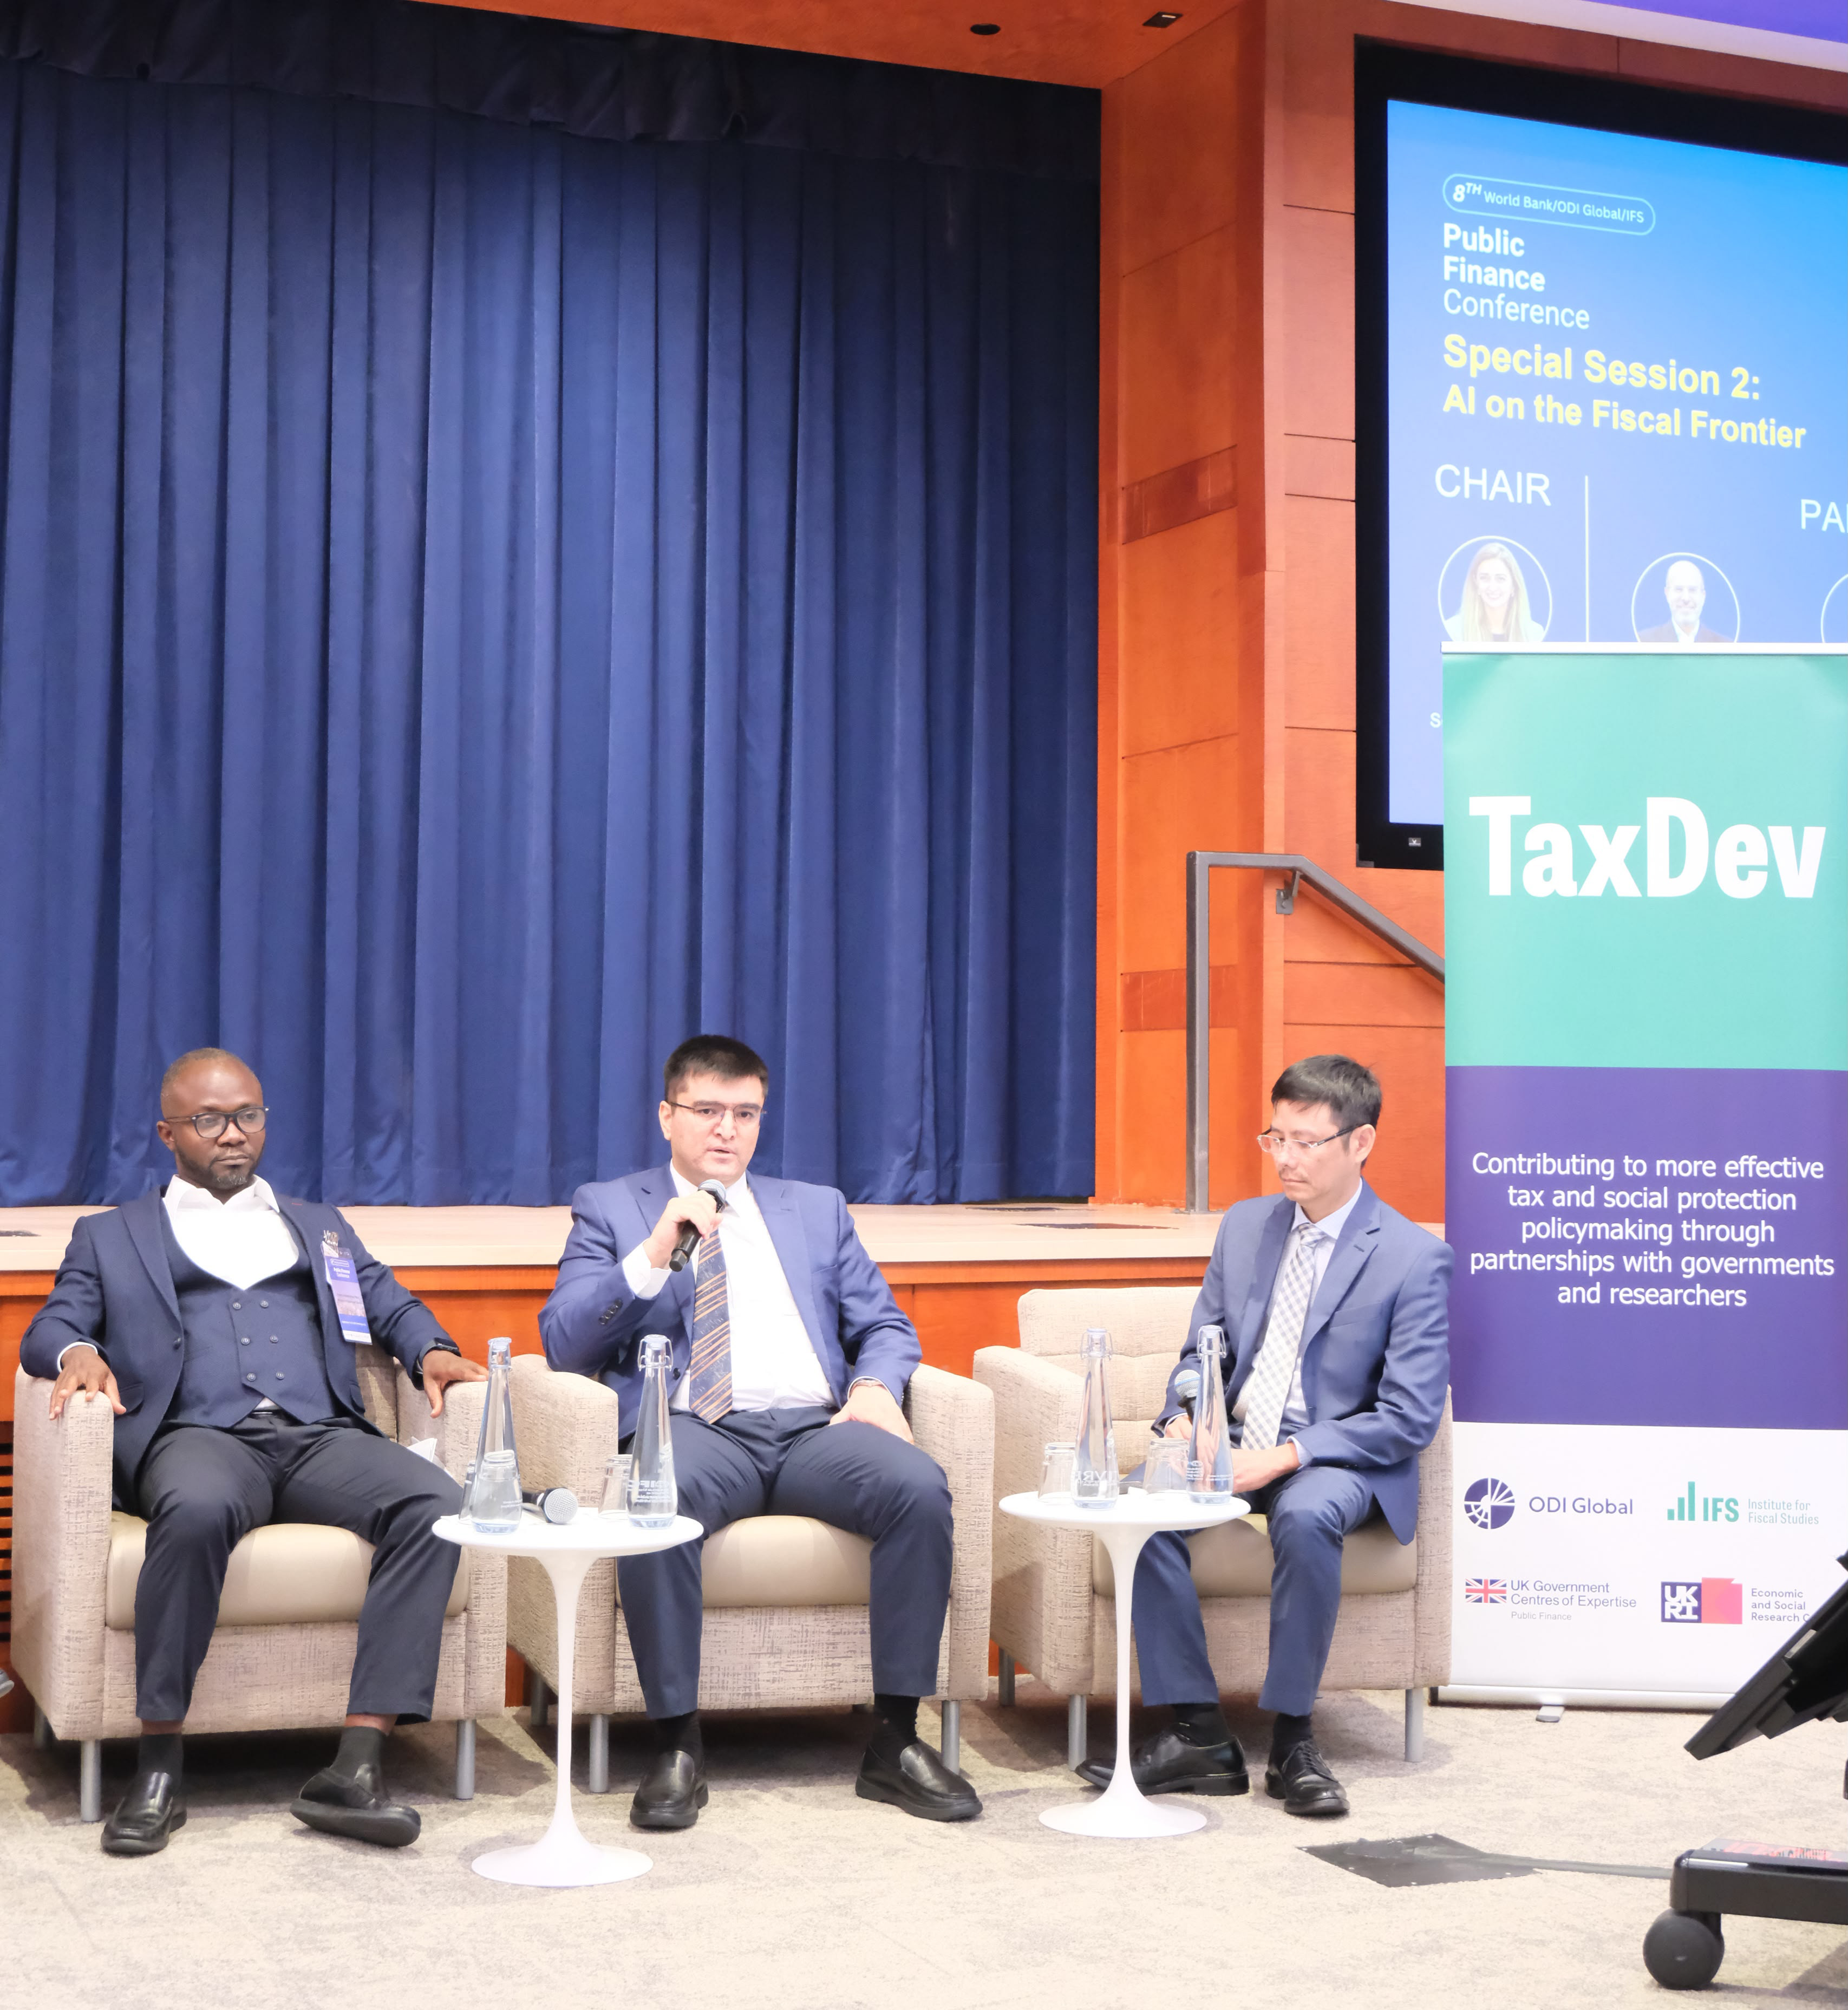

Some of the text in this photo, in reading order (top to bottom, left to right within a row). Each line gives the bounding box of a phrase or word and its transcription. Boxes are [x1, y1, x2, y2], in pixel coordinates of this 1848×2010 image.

[1484, 191, 1520, 207] World
[1523, 195, 1579, 214] Bank/ODI
[1584, 204, 1644, 224] Global/IFS
[1444, 223, 1525, 257] Public
[1444, 256, 1545, 292] Finance
[1444, 289, 1589, 329] Conference
[1444, 334, 1760, 400] Special Session 2:
[1443, 384, 1806, 448] AI on the Fiscal Frontier
[1435, 464, 1551, 506] CHAIR
[1801, 498, 1848, 533] PA
[1469, 795, 1826, 899] TaxDev
[1472, 1152, 1824, 1180] Contributing to more effective
[1508, 1185, 1796, 1213] tax and social protection
[1522, 1217, 1774, 1247] policymaking through
[1470, 1249, 1834, 1278] partnerships with governments
[1558, 1282, 1747, 1306] and researchers
[1529, 1496, 1633, 1515] ODI Global
[1703, 1497, 1739, 1522] IFS
[1748, 1498, 1811, 1512] Institute for
[1748, 1511, 1819, 1525] Fiscal Studies
[1511, 1580, 1609, 1593] UK Government
[1751, 1588, 1804, 1598] Economic
[1511, 1594, 1636, 1609] Centres of Expertise
[1751, 1601, 1806, 1610] and Social
[1511, 1611, 1572, 1621] Public Finance
[1751, 1612, 1800, 1622] Research
